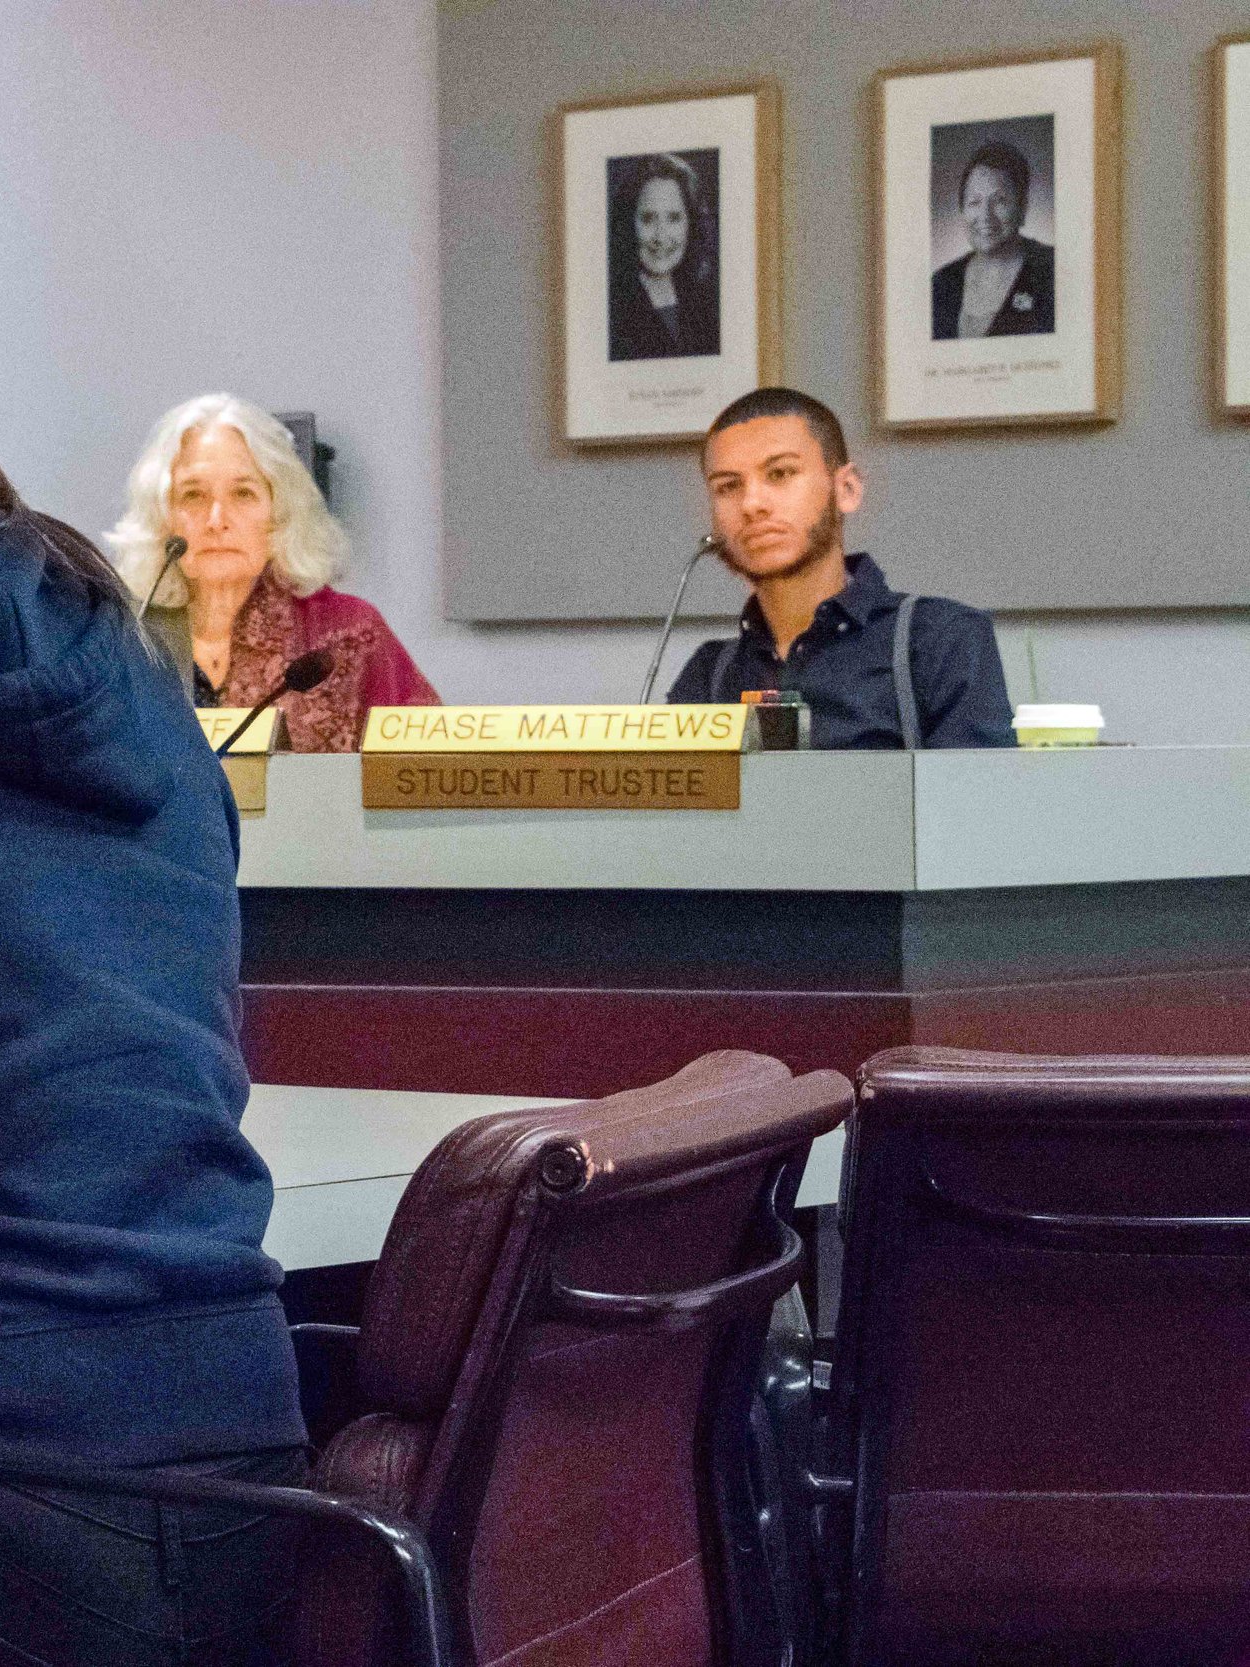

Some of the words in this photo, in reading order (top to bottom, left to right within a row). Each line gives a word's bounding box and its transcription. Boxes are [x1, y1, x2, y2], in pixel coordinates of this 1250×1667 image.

[379, 712, 500, 741] CHASE
[517, 710, 734, 740] MATTHEWS
[395, 768, 541, 797] STUDENT
[559, 768, 707, 796] TRUSTEE
